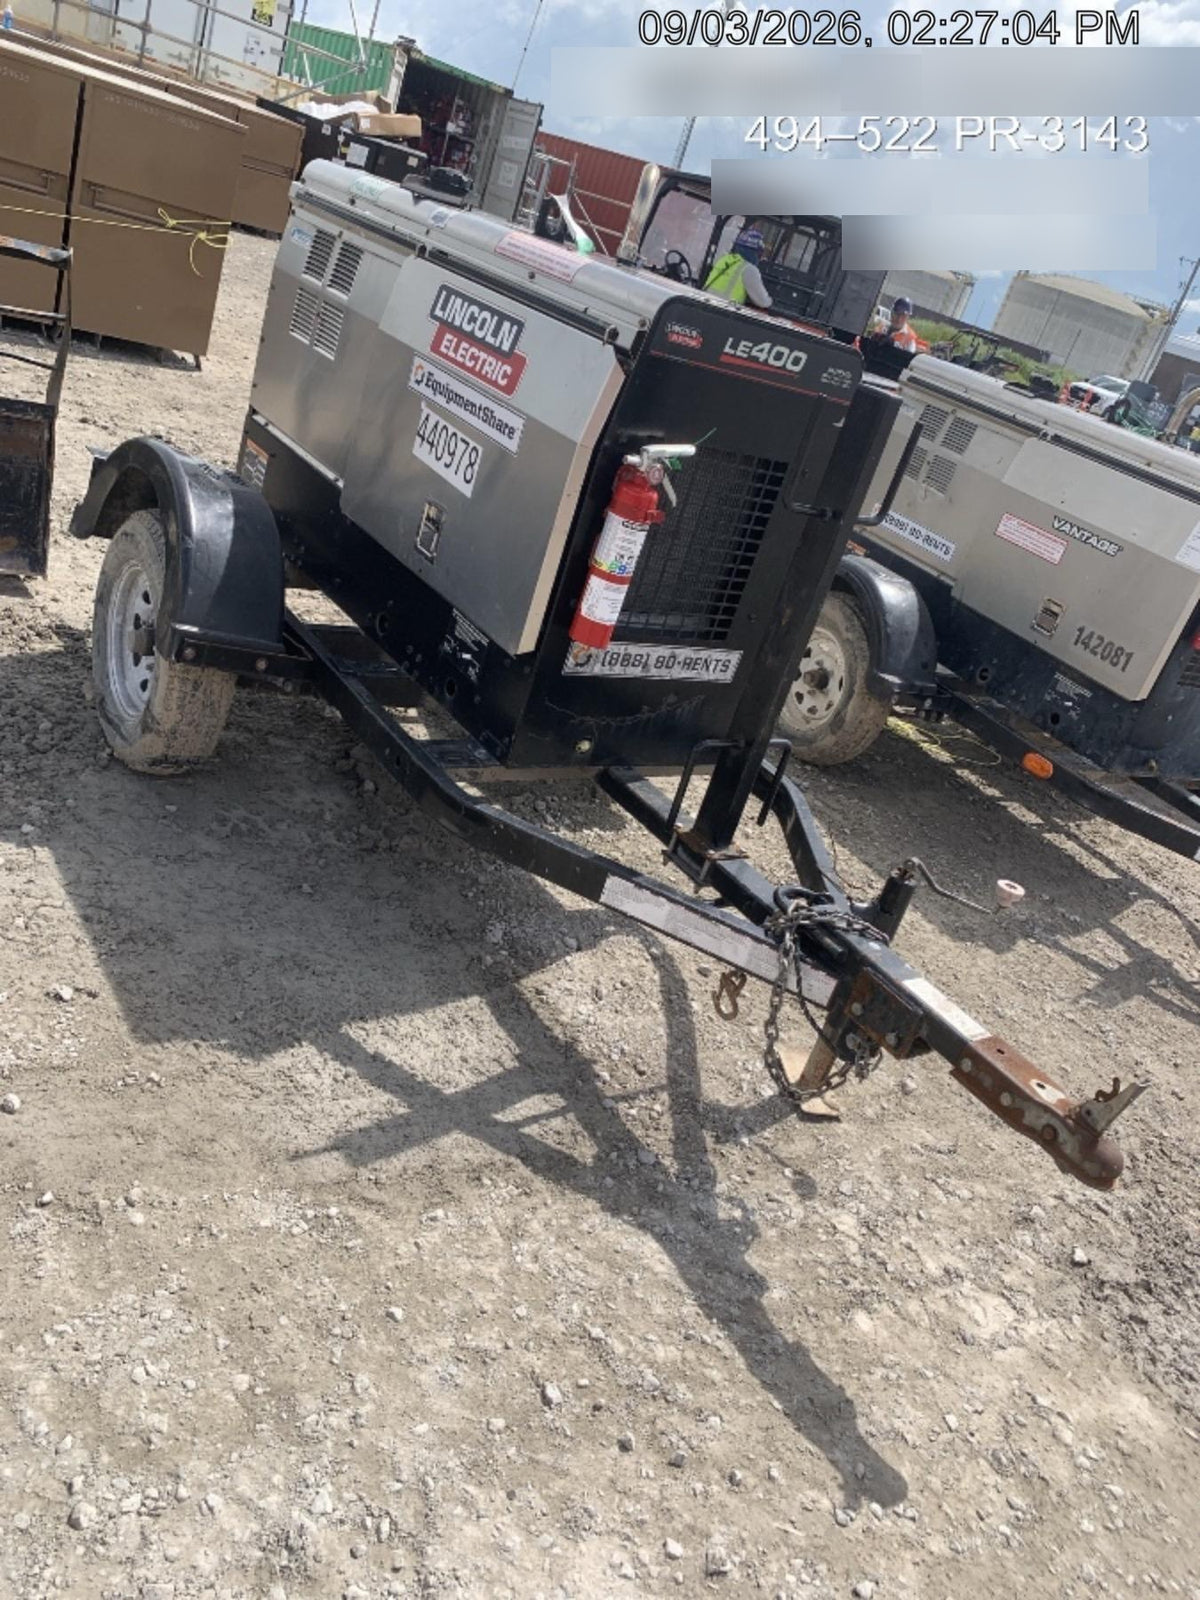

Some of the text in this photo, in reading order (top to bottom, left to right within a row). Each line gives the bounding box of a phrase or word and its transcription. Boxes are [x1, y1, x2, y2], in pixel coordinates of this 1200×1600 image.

[434, 289, 518, 352] LINCOLN
[439, 332, 513, 386] ELECTRIC
[722, 337, 808, 373] LE400
[424, 371, 516, 440] EquipmentShare
[416, 413, 480, 484] 440978
[1052, 515, 1122, 557] VANTAGE
[601, 651, 650, 669] (888)
[1073, 625, 1135, 673] 142081
